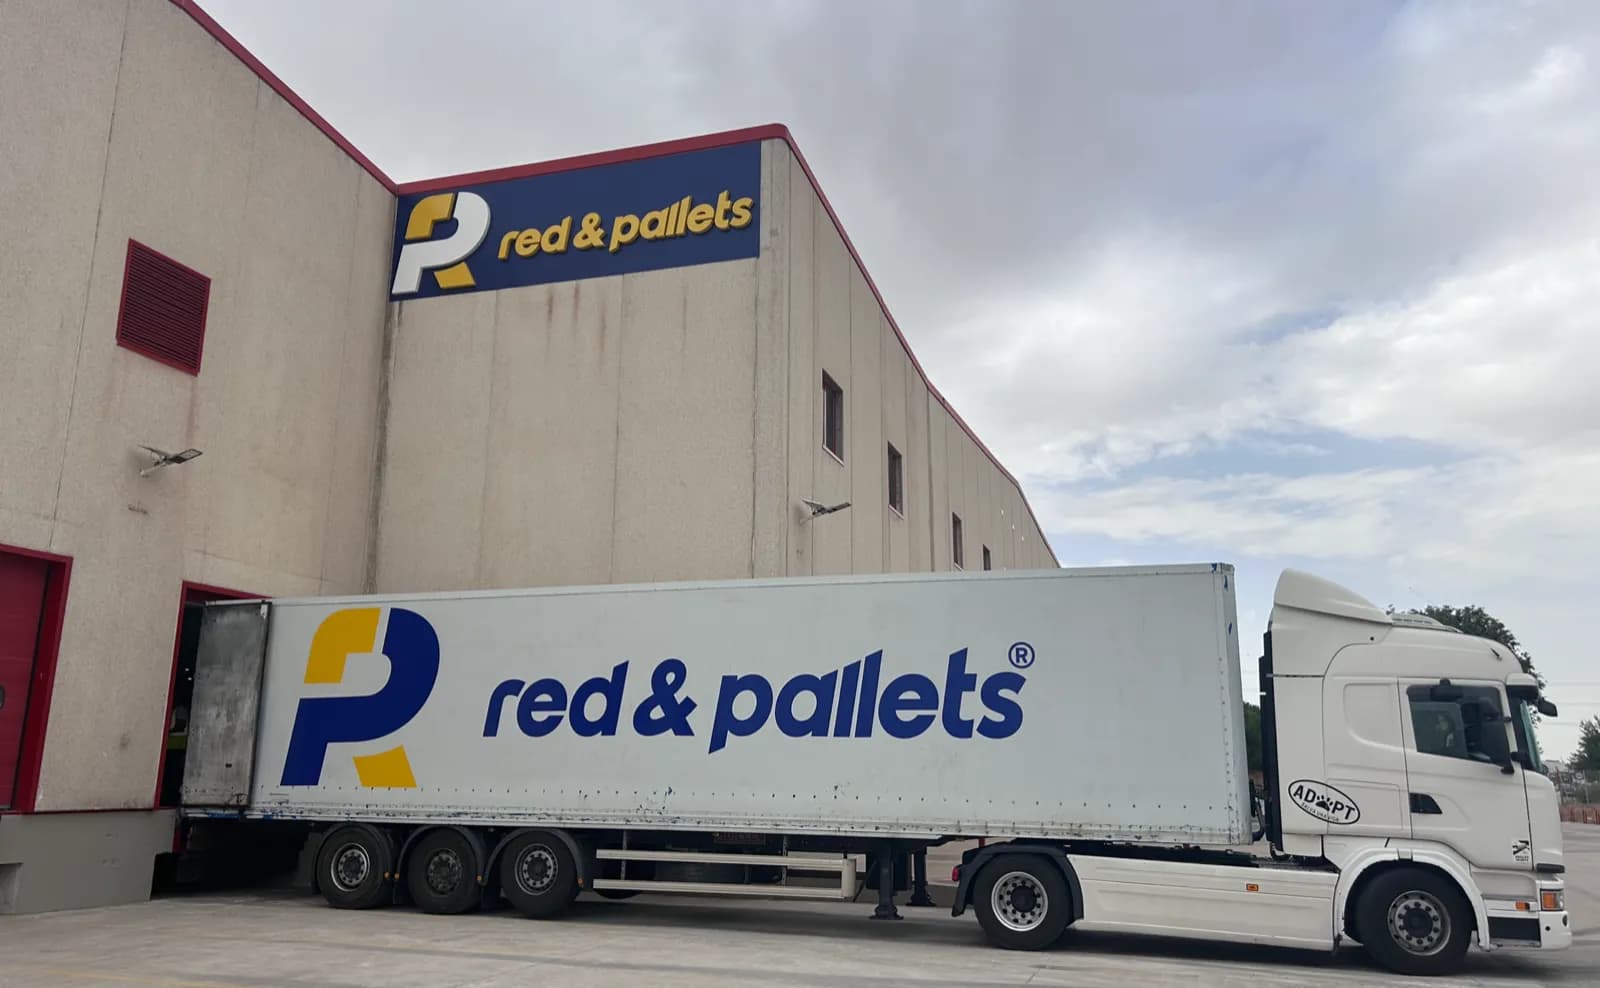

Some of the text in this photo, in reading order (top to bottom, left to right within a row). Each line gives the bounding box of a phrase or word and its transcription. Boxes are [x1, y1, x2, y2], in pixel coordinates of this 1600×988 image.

[497, 190, 754, 260] red & pallets
[483, 660, 629, 737] red
[633, 658, 697, 736] &
